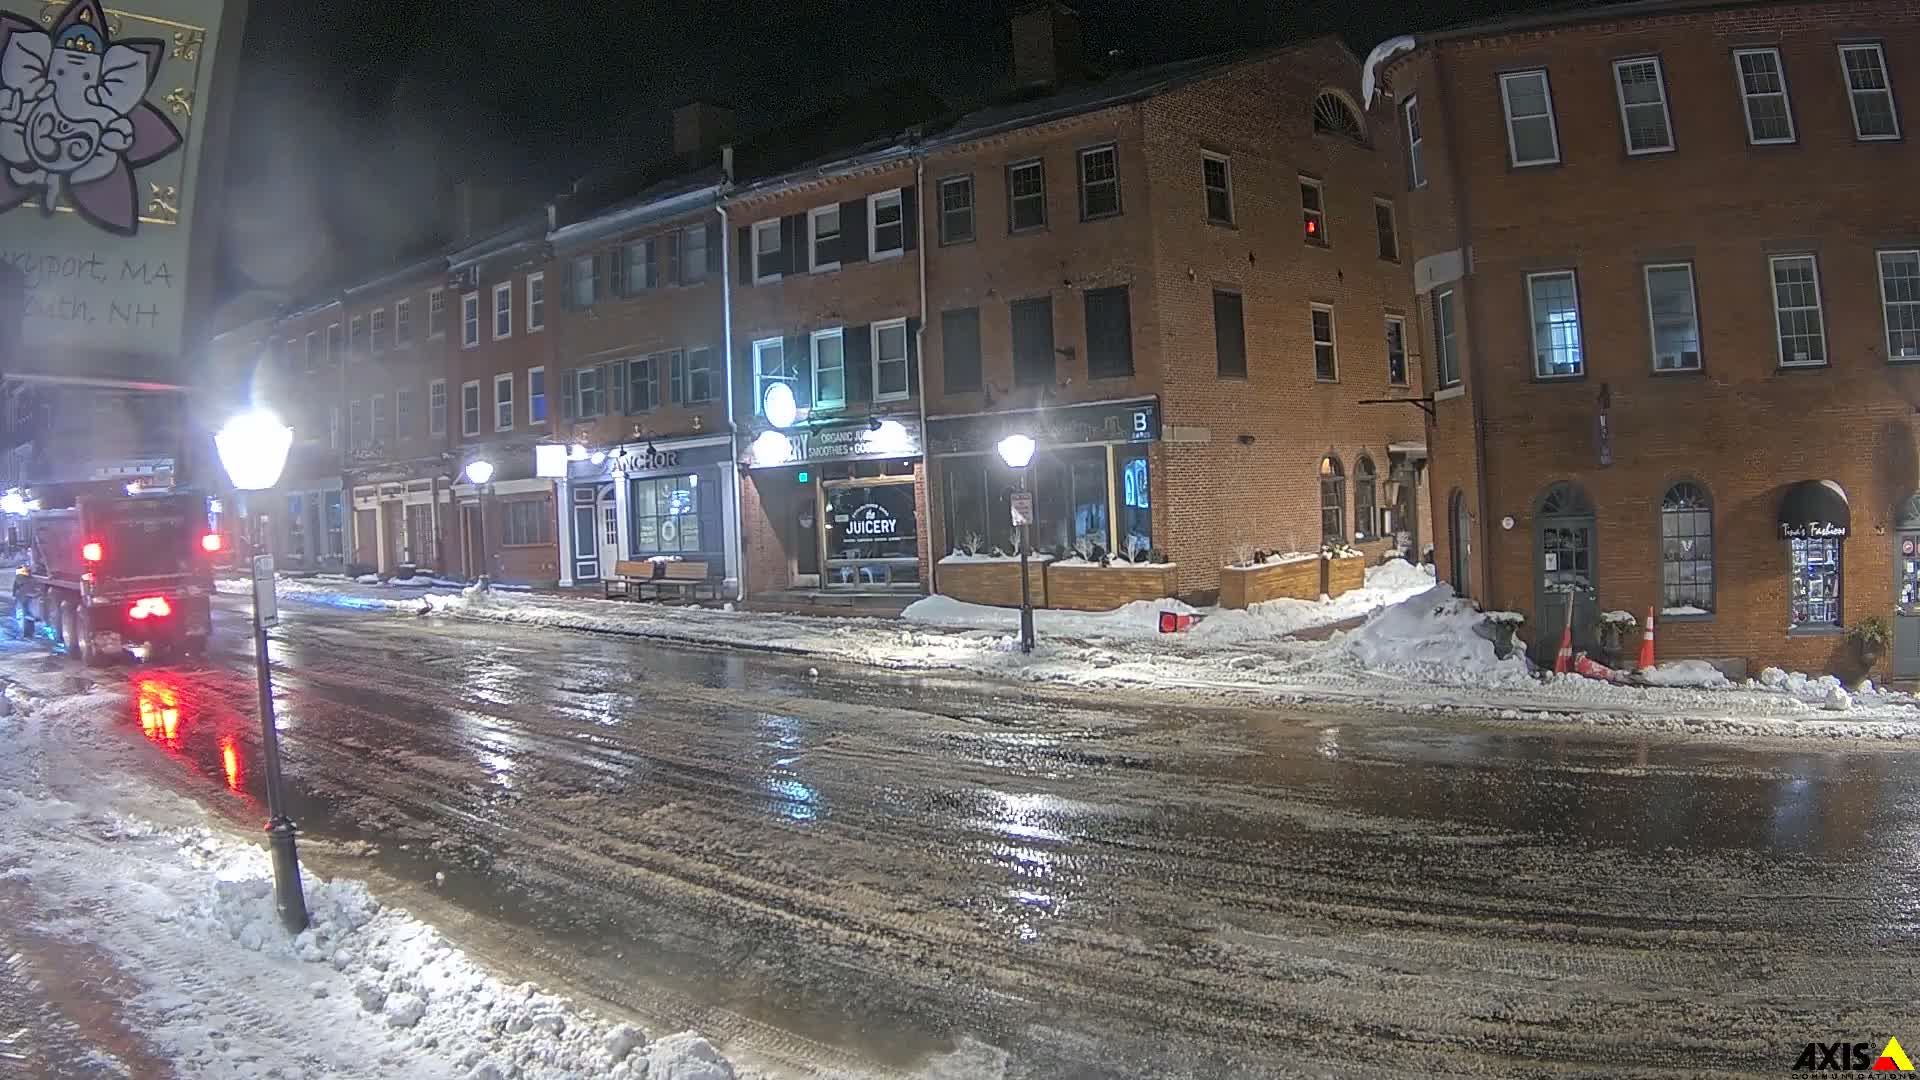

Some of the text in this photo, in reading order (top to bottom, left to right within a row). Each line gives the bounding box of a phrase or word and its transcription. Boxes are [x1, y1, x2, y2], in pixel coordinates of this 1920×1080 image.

[109, 297, 160, 328] NH
[1133, 412, 1147, 431] B
[821, 431, 853, 444] ORGANIC
[808, 444, 848, 457] SMOOTHIES
[611, 450, 681, 471] ANCHOR
[845, 518, 897, 535] JUICERY
[1782, 522, 1806, 537] Tina's
